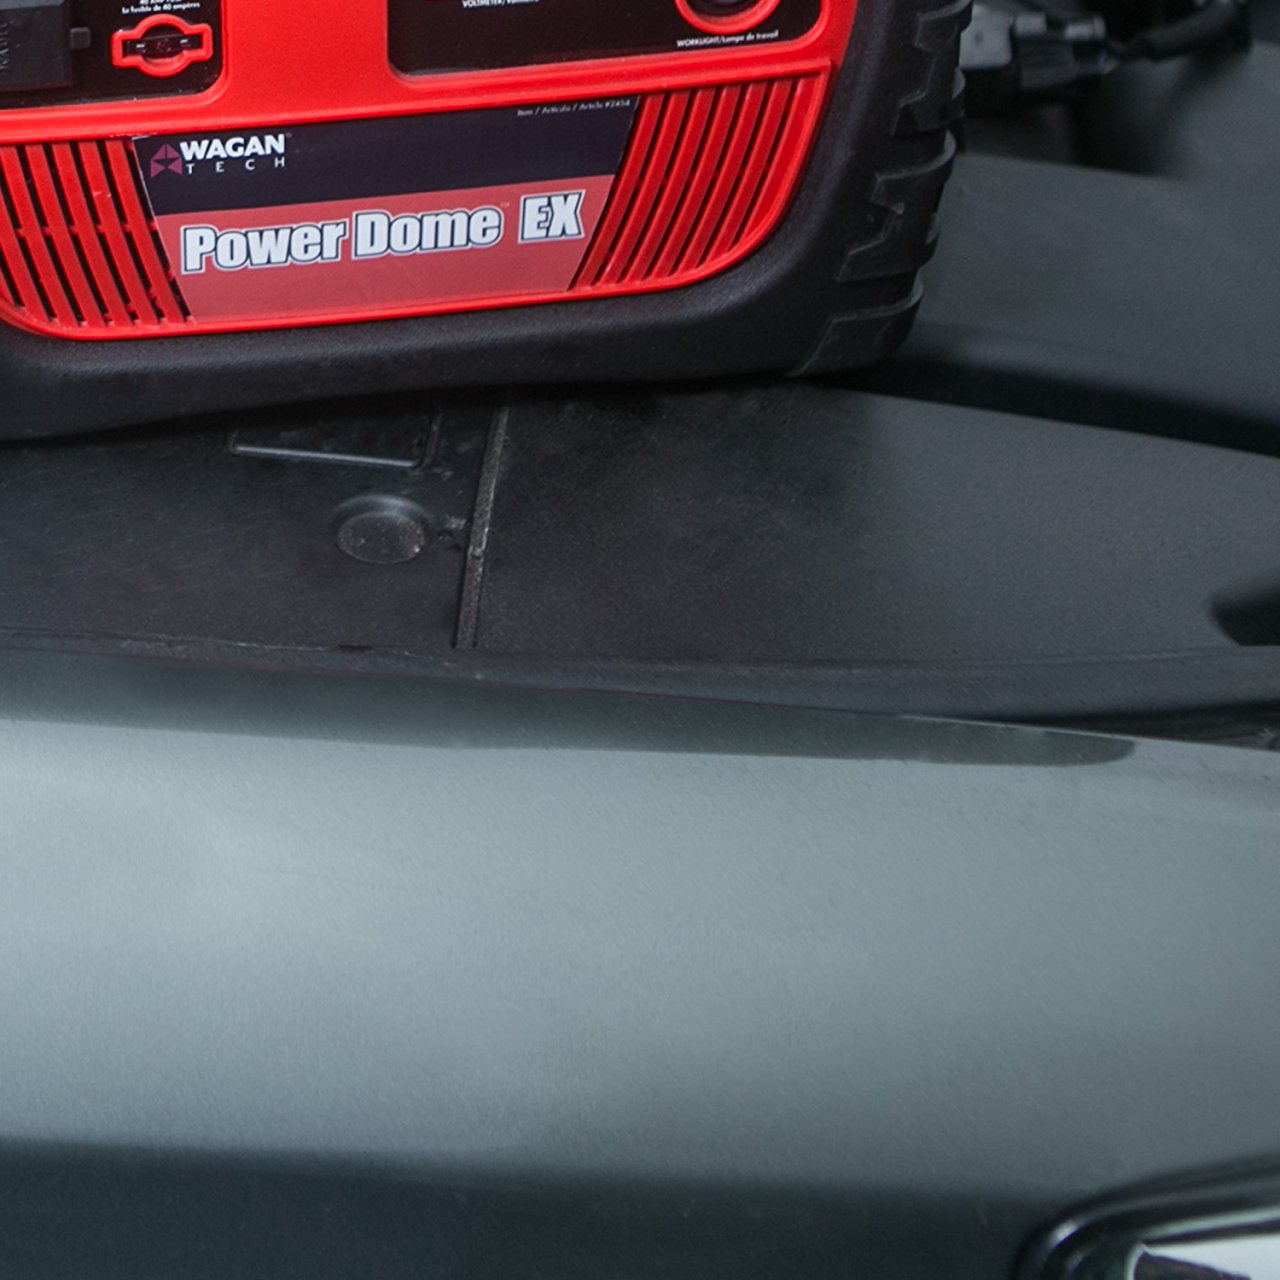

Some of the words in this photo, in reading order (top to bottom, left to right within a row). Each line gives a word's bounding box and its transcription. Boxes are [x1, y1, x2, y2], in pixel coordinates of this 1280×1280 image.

[180, 133, 285, 161] WAGAN
[186, 157, 285, 174] TECH
[181, 217, 347, 274] Power
[351, 205, 504, 260] Dome
[518, 190, 586, 243] EX
